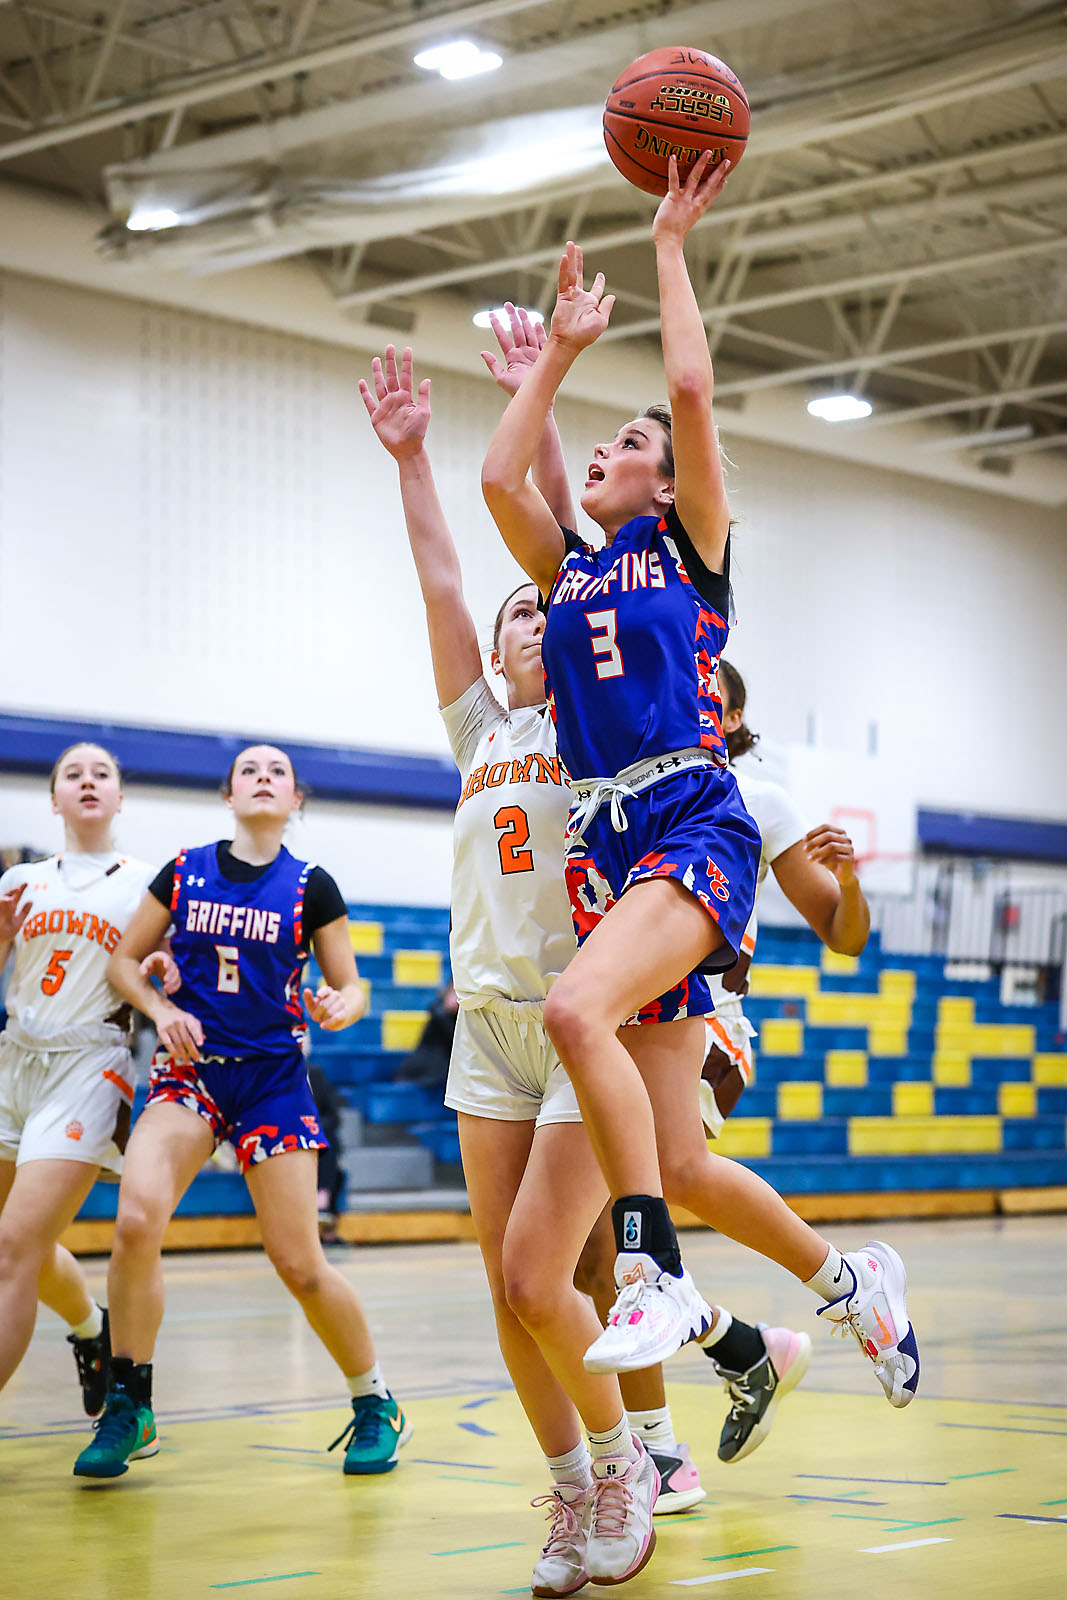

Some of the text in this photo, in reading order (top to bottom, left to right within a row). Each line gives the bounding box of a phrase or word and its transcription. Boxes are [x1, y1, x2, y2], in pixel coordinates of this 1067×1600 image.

[650, 96, 734, 127] LEGACY
[584, 608, 625, 680] 3
[627, 769, 655, 788] UNDER
[494, 805, 534, 875] 2
[186, 899, 281, 944] GRIFFINS
[41, 950, 73, 996] 5
[214, 944, 240, 994] 6
